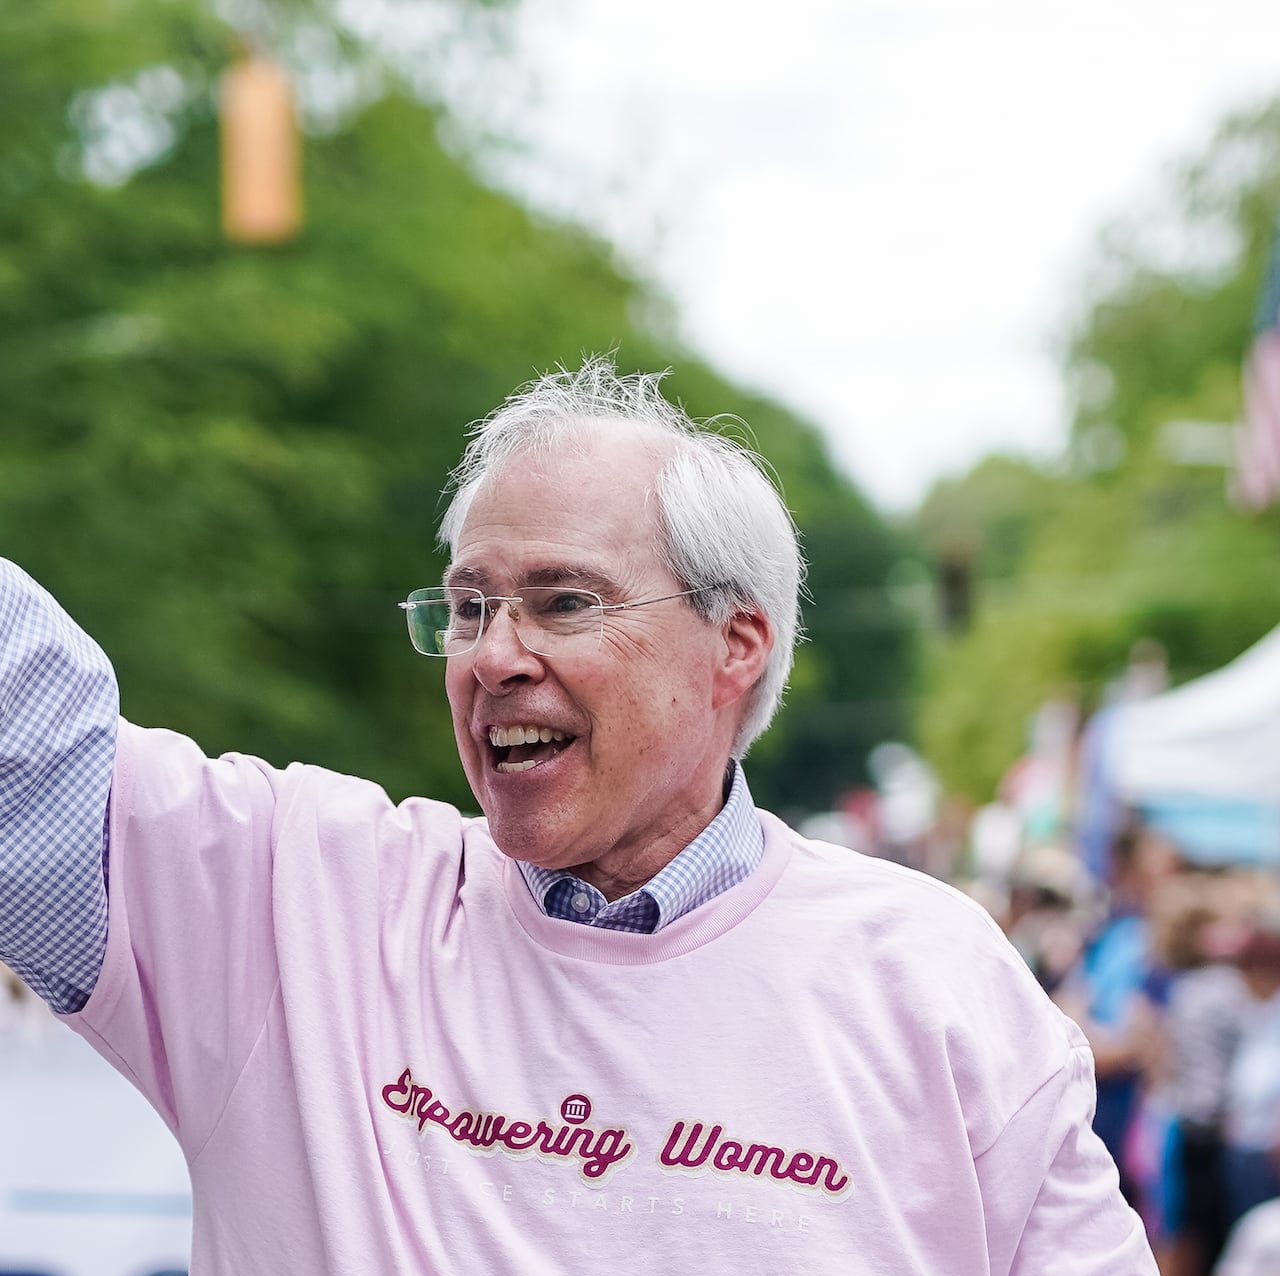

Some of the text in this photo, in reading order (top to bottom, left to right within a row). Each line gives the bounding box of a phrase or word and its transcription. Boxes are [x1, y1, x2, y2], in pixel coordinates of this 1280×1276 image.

[381, 1067, 848, 1193] Empowering Women
[542, 1187, 686, 1217] STARTS
[716, 1199, 812, 1234] HERE
